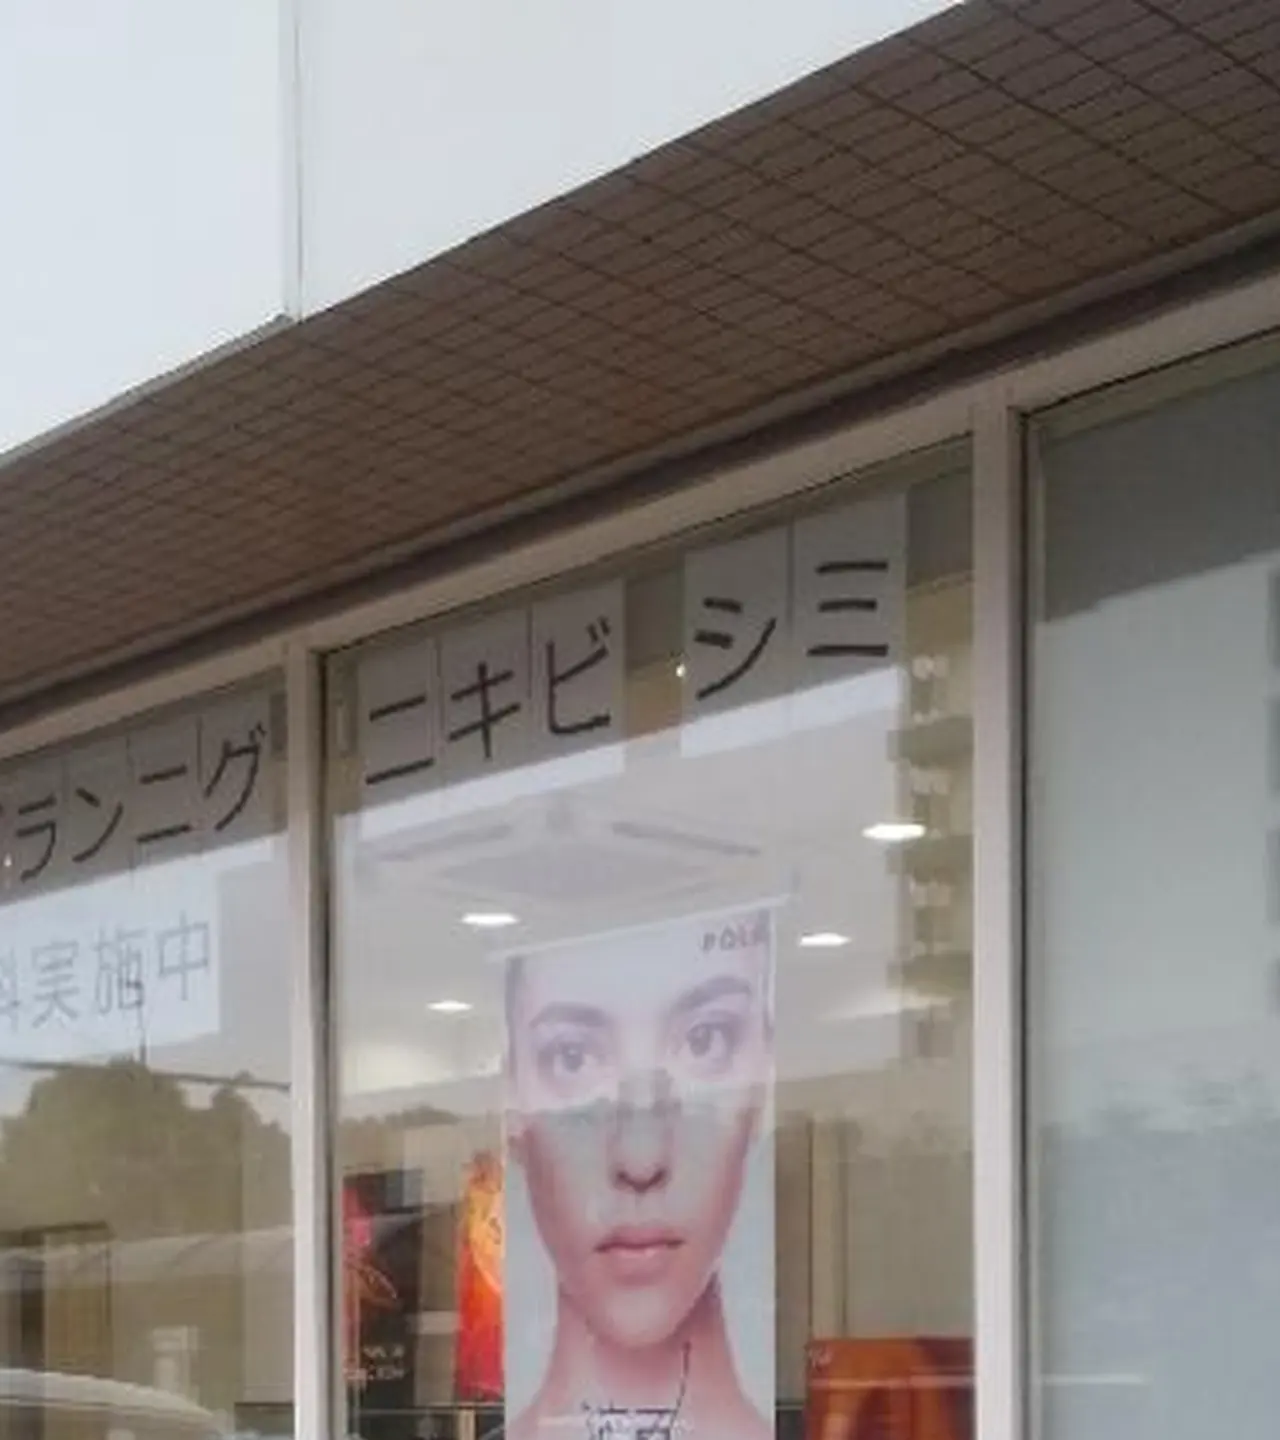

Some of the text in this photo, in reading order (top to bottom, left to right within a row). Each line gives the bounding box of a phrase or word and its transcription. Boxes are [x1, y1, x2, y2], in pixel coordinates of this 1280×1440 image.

[365, 561, 889, 785] ニキビ シミ
